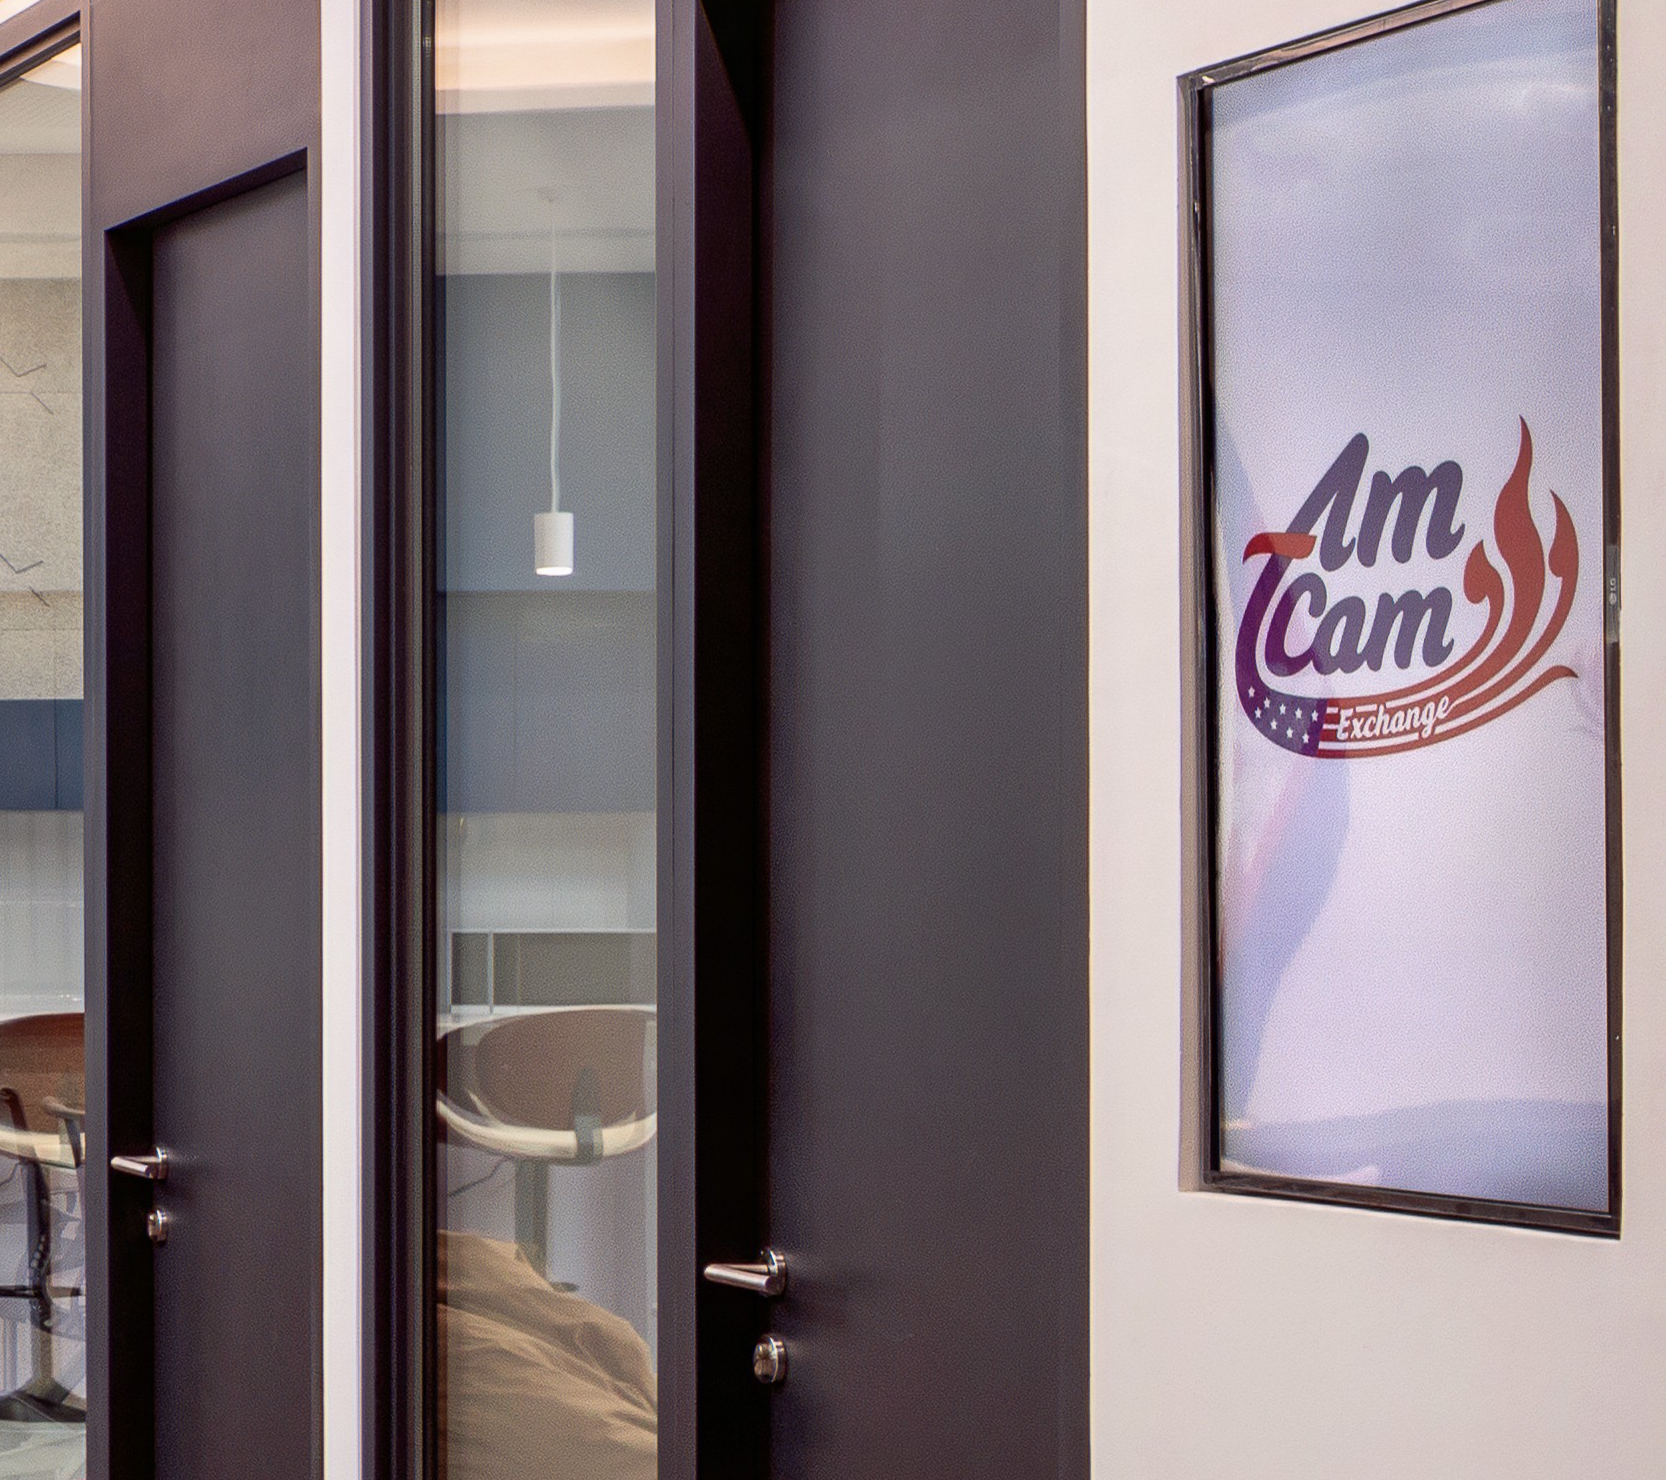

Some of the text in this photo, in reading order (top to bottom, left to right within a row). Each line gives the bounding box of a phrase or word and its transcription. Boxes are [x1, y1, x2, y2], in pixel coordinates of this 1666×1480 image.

[1242, 432, 1466, 572] Am
[1263, 572, 1455, 678] Cam
[1336, 695, 1451, 741] Exchange
